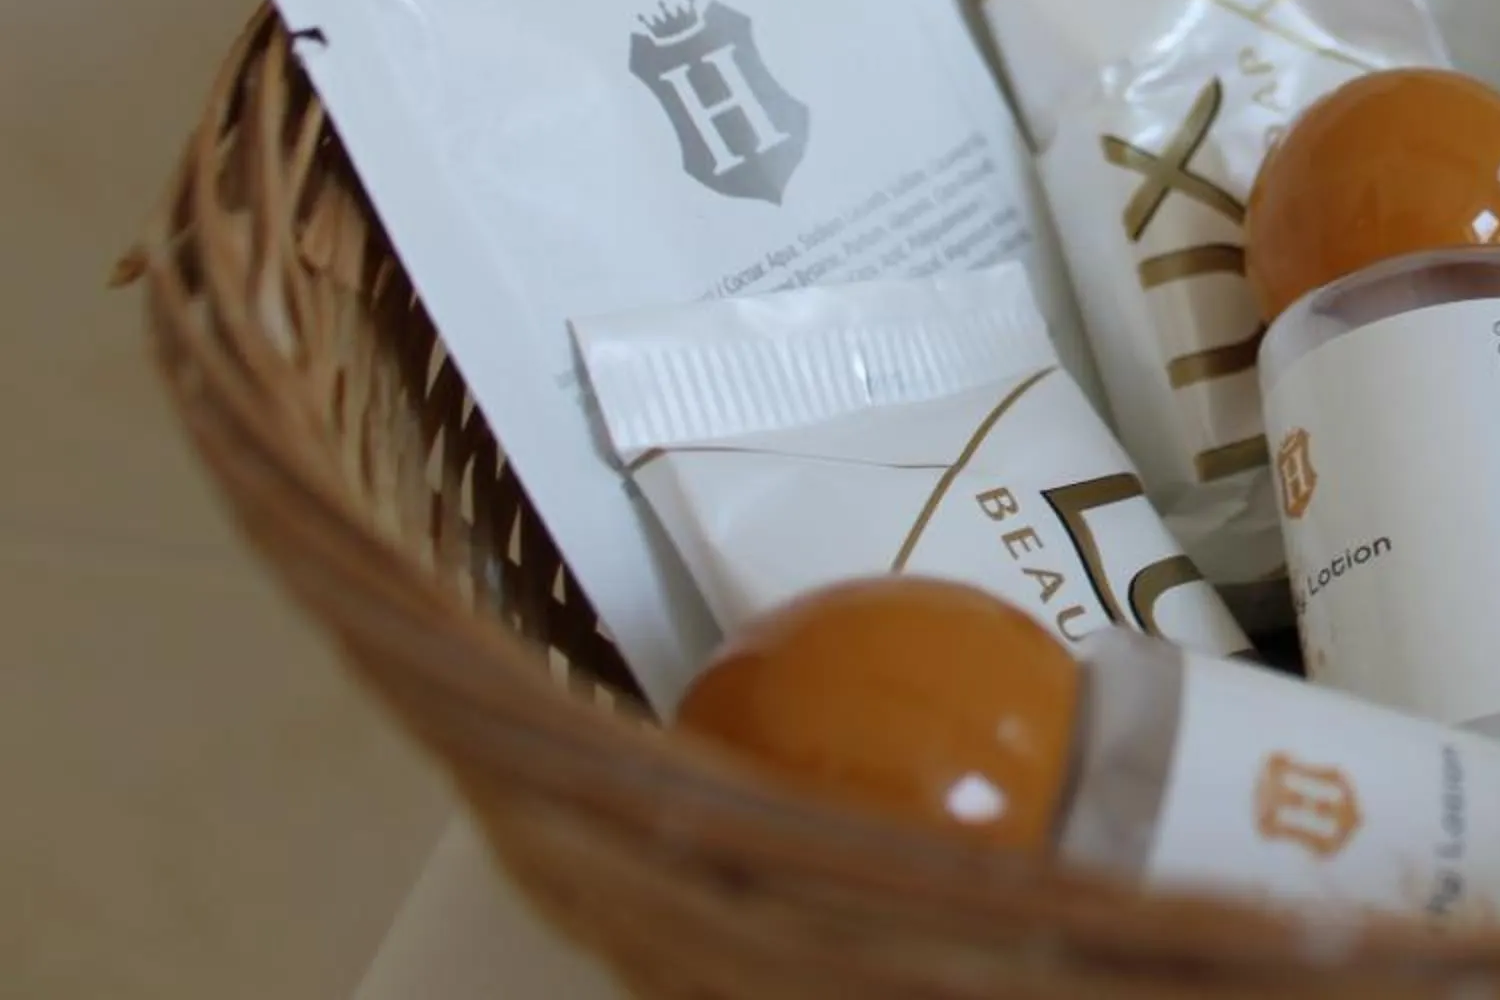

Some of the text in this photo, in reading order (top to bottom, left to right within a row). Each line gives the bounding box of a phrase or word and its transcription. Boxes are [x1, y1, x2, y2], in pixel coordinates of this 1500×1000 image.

[660, 44, 791, 177] H
[976, 487, 1087, 643] BEAU
[1307, 535, 1392, 597] Lotion
